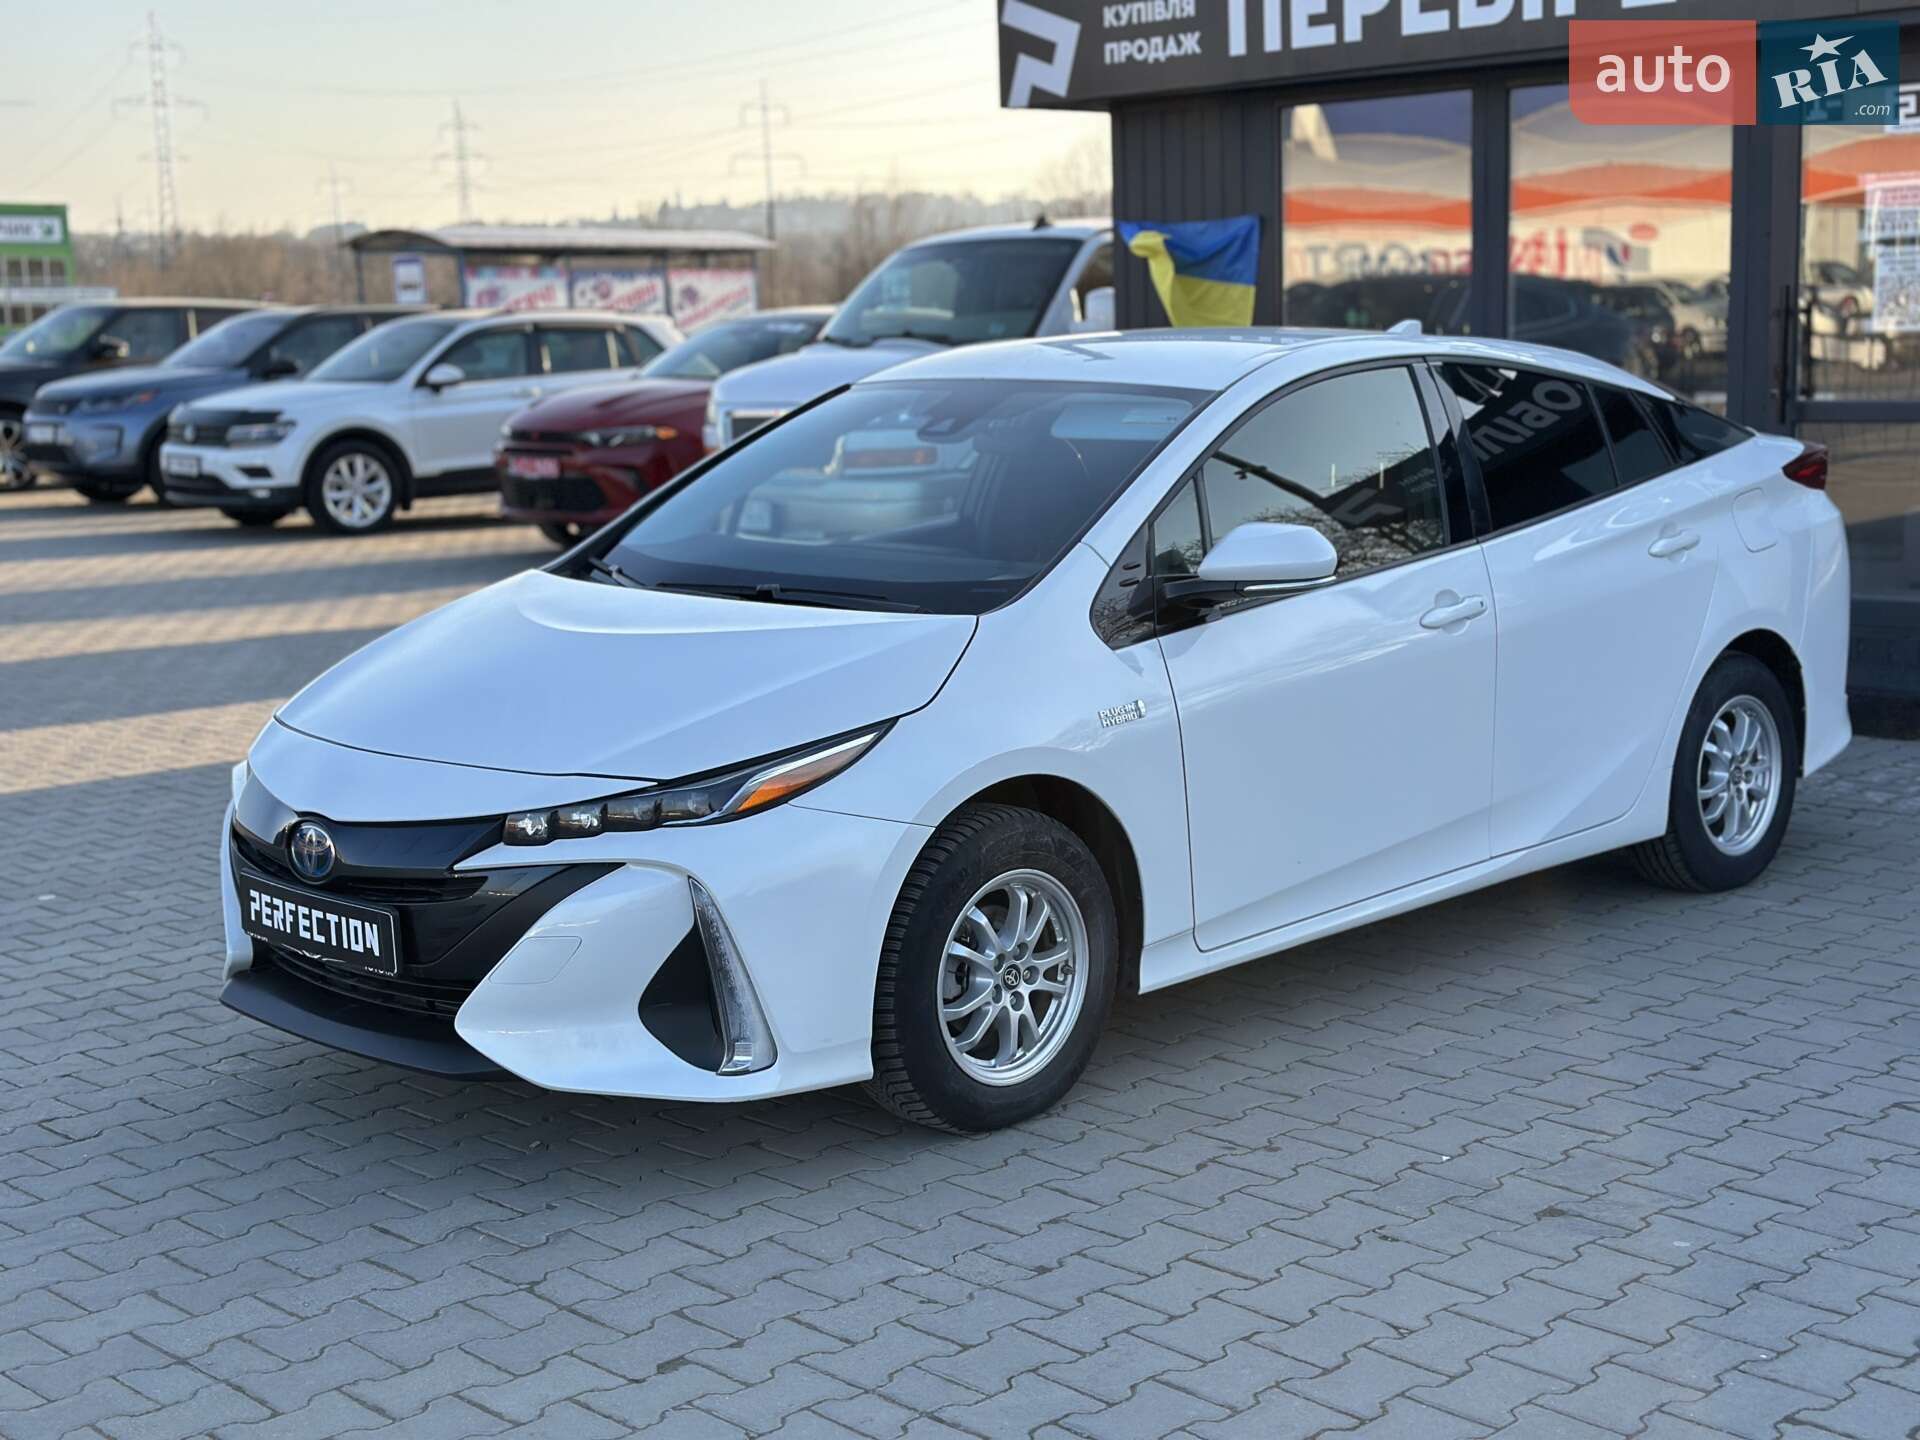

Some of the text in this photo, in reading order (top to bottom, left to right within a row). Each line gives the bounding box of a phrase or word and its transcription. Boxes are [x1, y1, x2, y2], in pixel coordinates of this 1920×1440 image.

[1103, 0, 1196, 28] КУПІВЛЯ
[1104, 32, 1202, 64] ПРОДАЖ
[1103, 711, 1138, 727] HYBRID
[250, 889, 380, 957] PERFECTION
